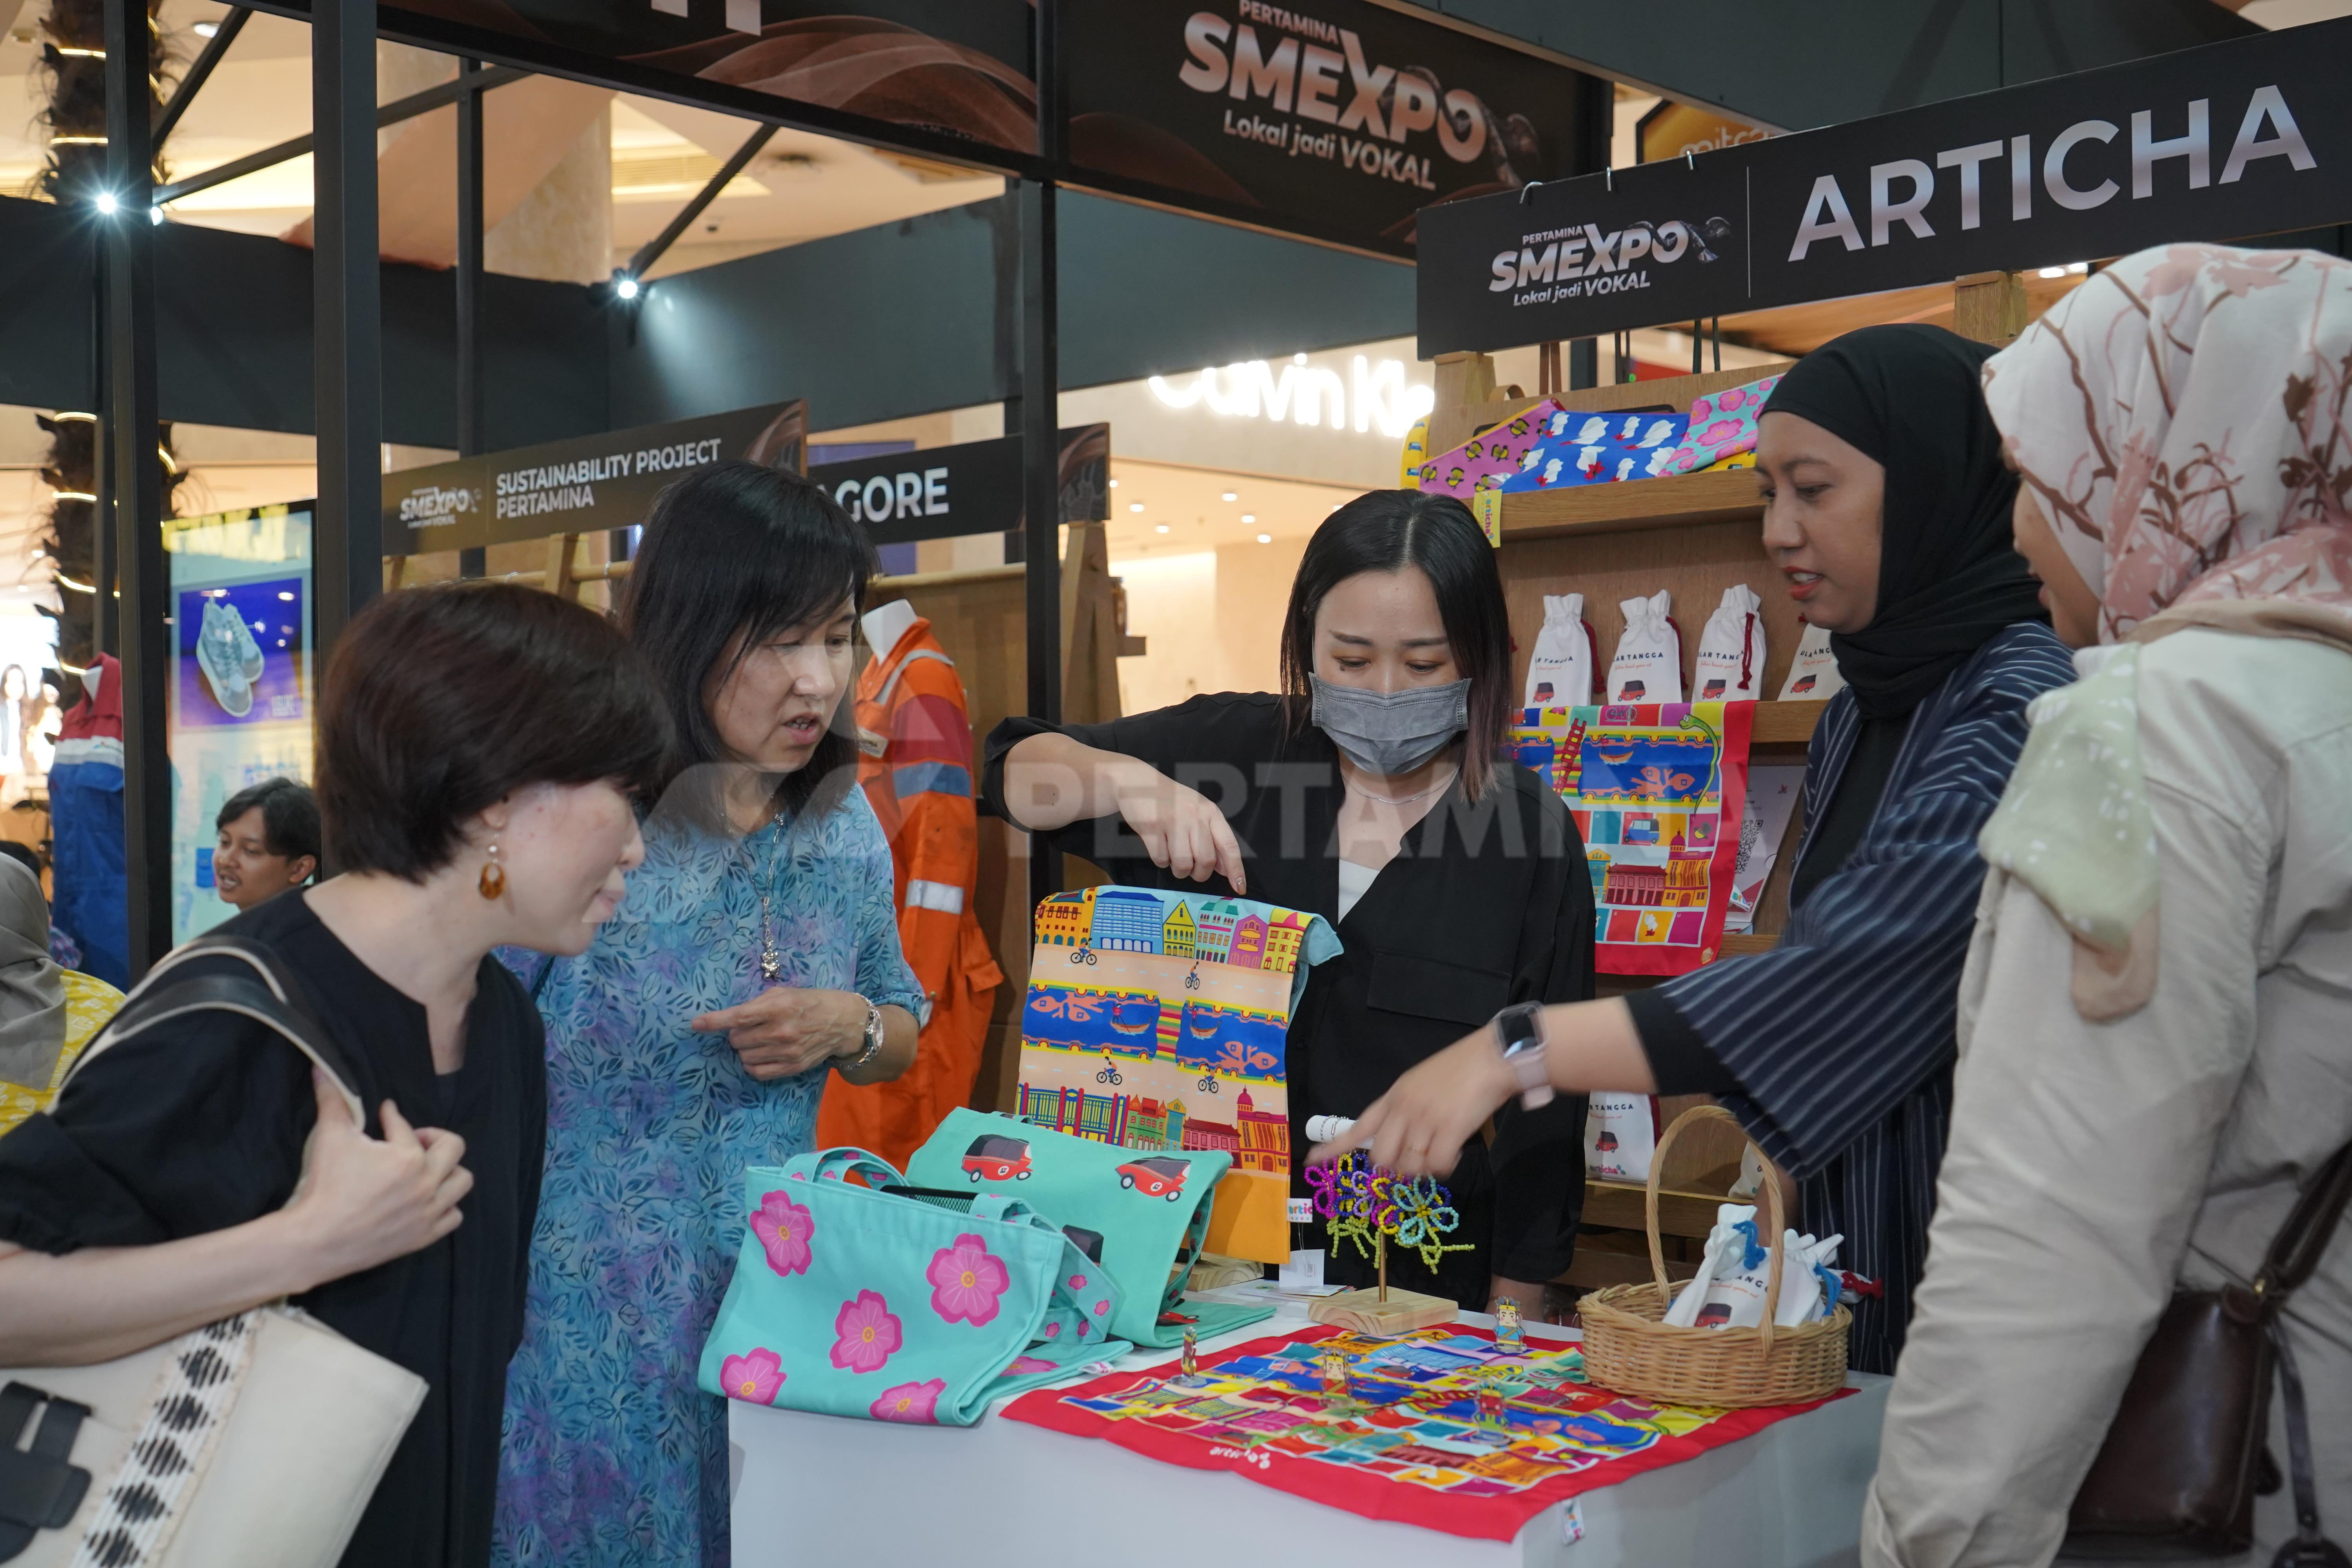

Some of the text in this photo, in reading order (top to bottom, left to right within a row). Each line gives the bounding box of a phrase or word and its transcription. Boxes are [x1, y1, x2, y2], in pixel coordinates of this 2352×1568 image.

[1239, 0, 1339, 45] PERTAMINA
[1179, 11, 1487, 163] SMEXPO
[1223, 109, 1437, 191] Lokal jadi VOKAL
[1788, 85, 2318, 262] ARTICHA
[1489, 220, 1689, 292] SMEXPO
[1523, 225, 1583, 245] PERTAMINA
[1514, 270, 1651, 307] Lokal jadi VOKAL
[497, 439, 722, 495] SUSTAINABILITY PROJECT
[399, 486, 470, 521] SMEXPO
[497, 485, 595, 519] PERTAMINA
[817, 466, 950, 523] GORE
[1627, 652, 1663, 661] TANGGA
